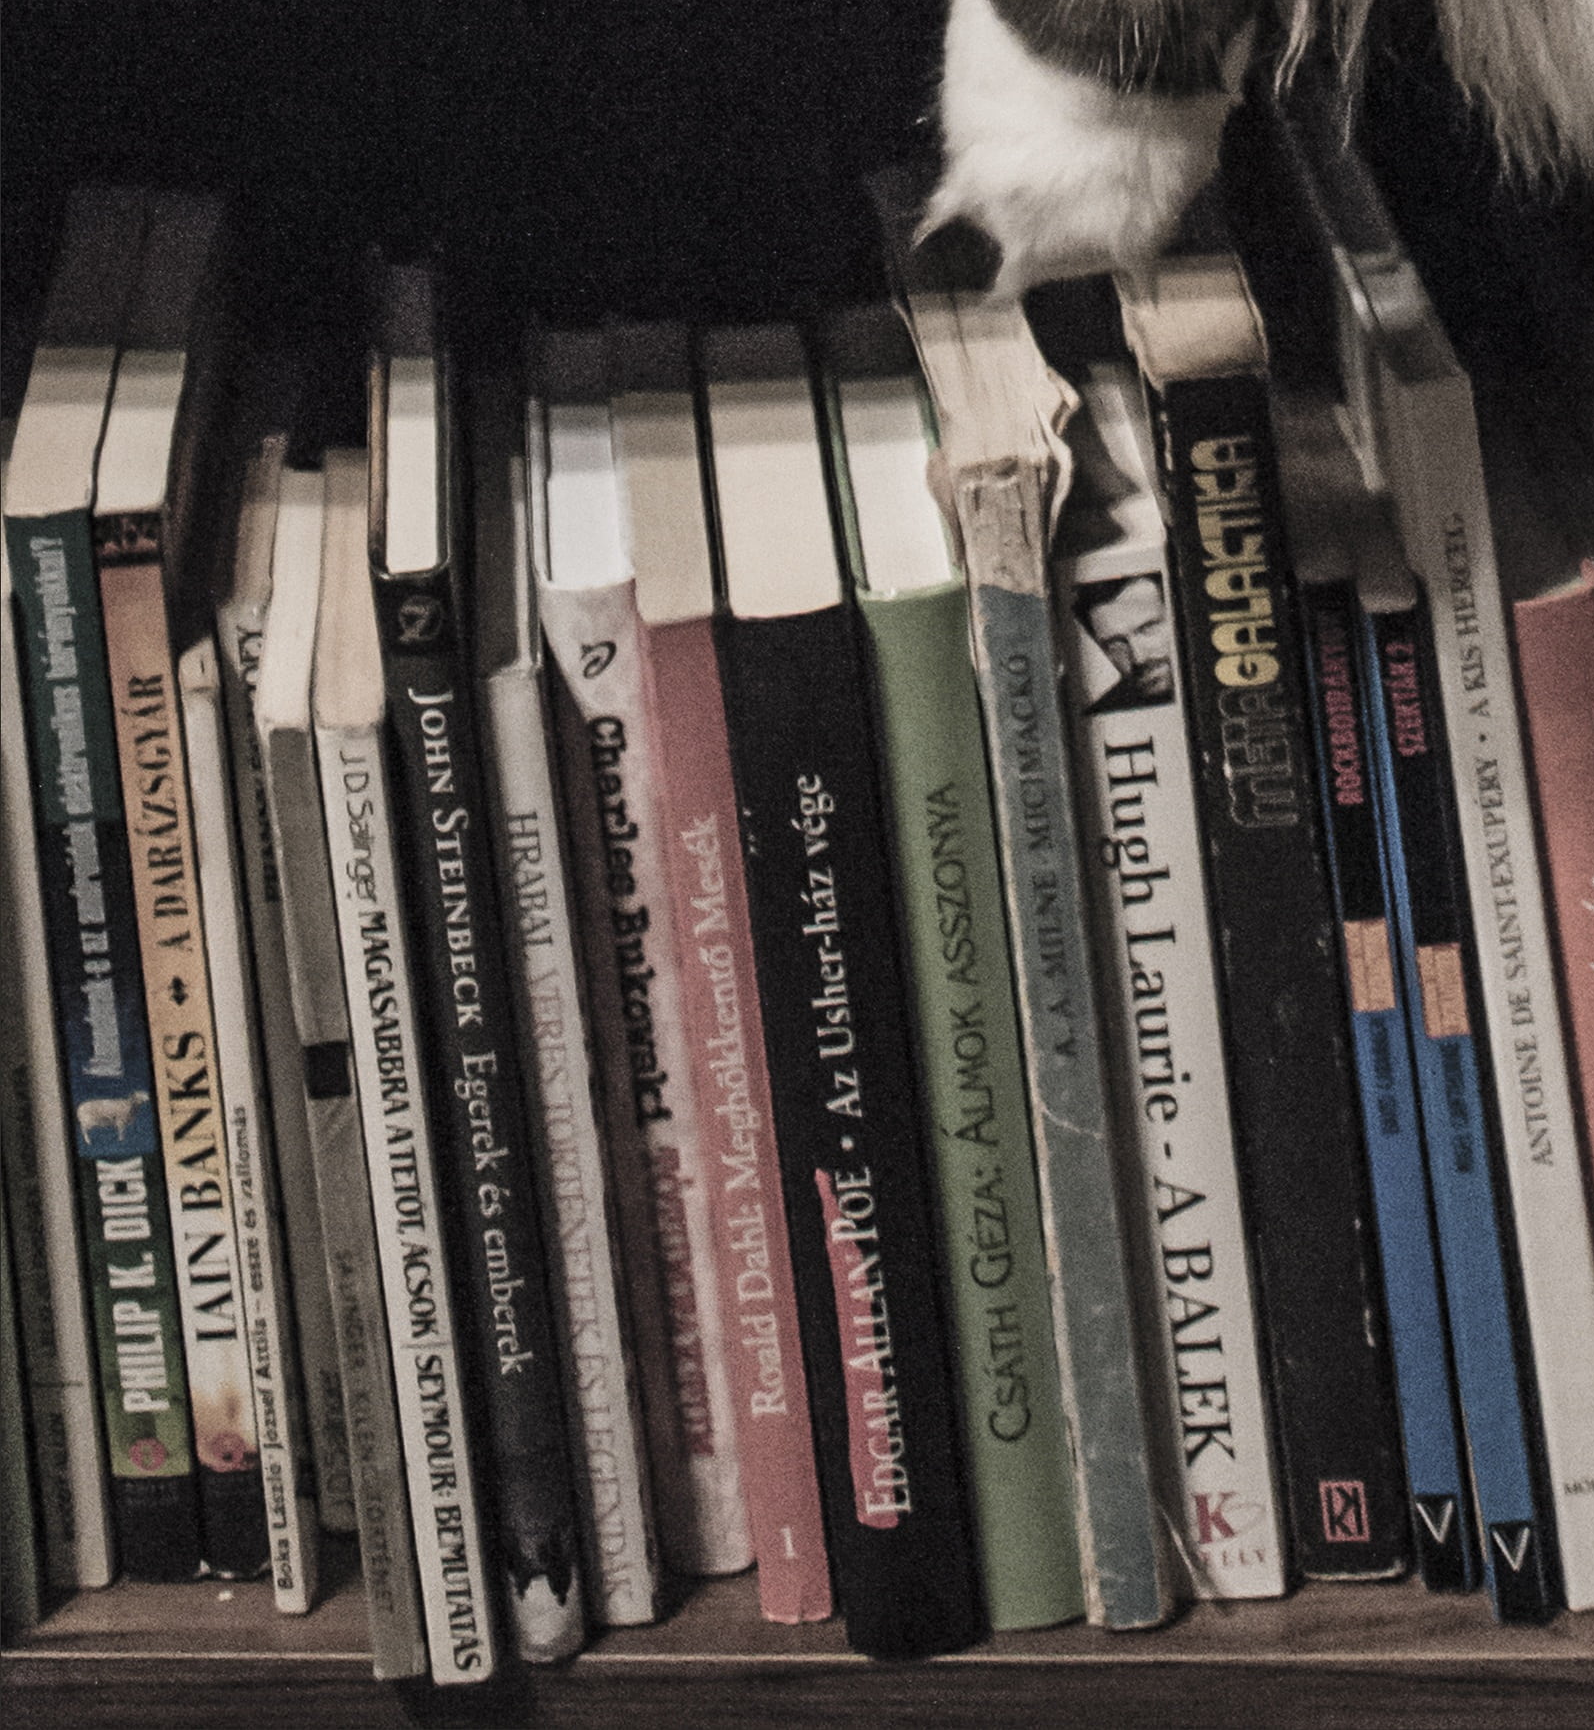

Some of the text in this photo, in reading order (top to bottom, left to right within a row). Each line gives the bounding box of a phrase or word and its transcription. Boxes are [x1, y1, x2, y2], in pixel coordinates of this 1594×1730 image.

[121, 673, 239, 1343] IAIN BANKS A DARÁZSGYÁR
[357, 909, 412, 1115] MAGASABBRA
[407, 686, 483, 1028] JOHN STEINBECK
[506, 811, 554, 947] HRABAL
[1463, 644, 1555, 1168] ANTOINE DE KIS
[95, 1157, 149, 1242] DICK
[453, 1048, 534, 1377] Egerek és emberek
[679, 813, 788, 1419] Roald Dahl: Meghökkentő Mesék
[790, 772, 914, 1518] EDGAR ALLAN POE Az Usher-ház vége
[925, 781, 1033, 1444] CSÁTH ÁLMOK ASSZONYA
[1101, 733, 1237, 1470] Hugh Laurie A BALEK
[109, 1250, 155, 1291] K.
[110, 1300, 171, 1416] PHILIP
[414, 1354, 458, 1499] SEYMOUR:
